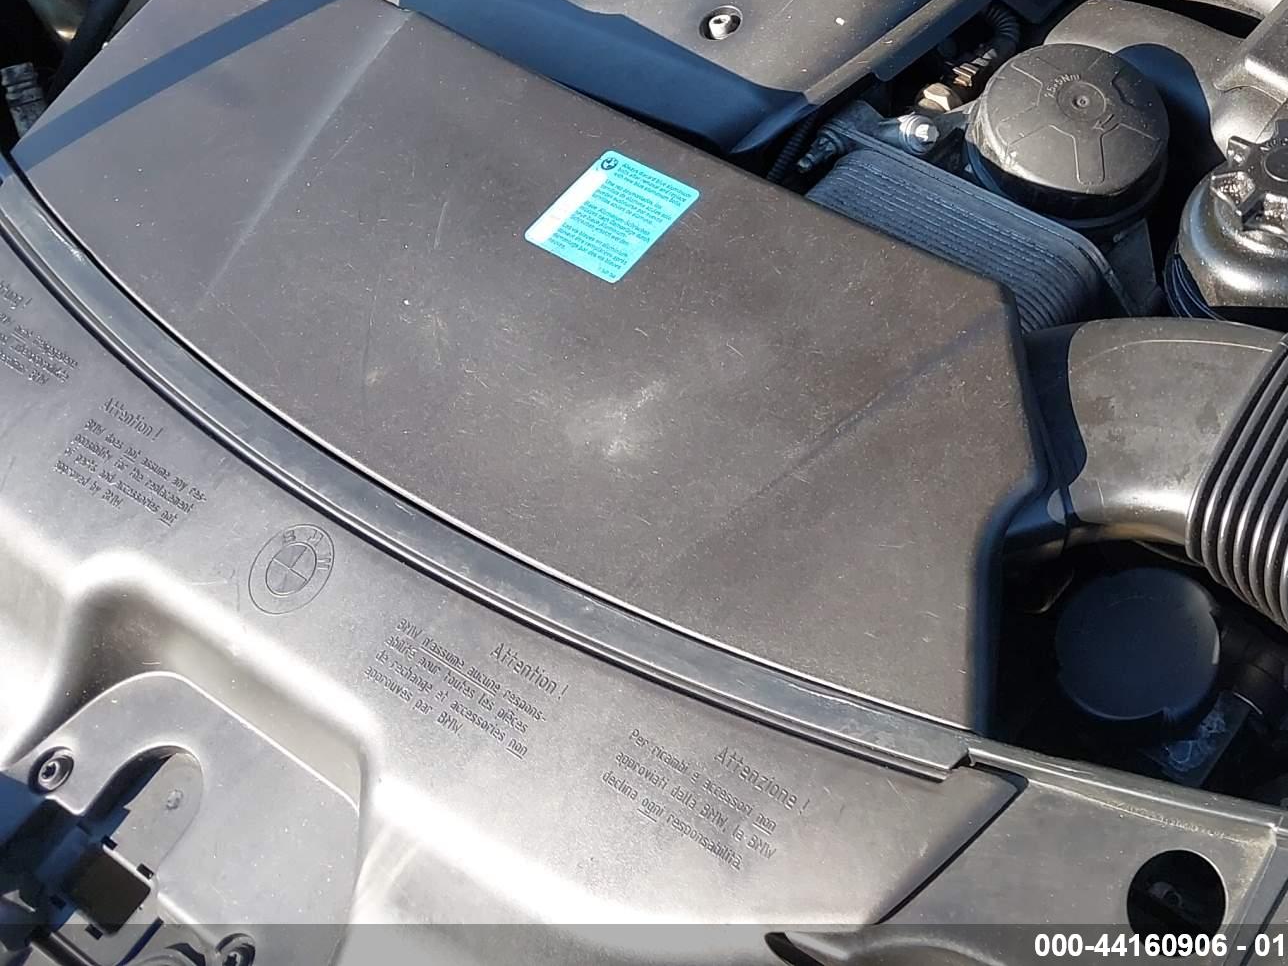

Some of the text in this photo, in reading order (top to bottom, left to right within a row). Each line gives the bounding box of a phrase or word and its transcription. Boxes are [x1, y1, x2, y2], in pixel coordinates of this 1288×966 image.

[89, 481, 101, 496] by
[105, 433, 123, 449] does
[123, 447, 141, 461] not
[141, 457, 170, 481] assume
[171, 476, 187, 491] any
[129, 467, 144, 482] the
[98, 470, 117, 485] and
[160, 510, 179, 525] not
[397, 618, 423, 639] BMW
[422, 636, 465, 670] n'assume
[466, 666, 501, 694] aucune
[418, 655, 441, 676] pour
[443, 669, 476, 699] toutes
[478, 693, 494, 711] les
[375, 650, 390, 664] de
[390, 659, 433, 694] rechange
[435, 689, 449, 703] et
[506, 738, 528, 757] non
[414, 699, 433, 715] par
[601, 770, 639, 801] declina
[639, 798, 666, 819] ogni
[629, 729, 649, 748] Per
[651, 746, 690, 774] ricambi
[702, 778, 755, 818] accessori
[754, 813, 777, 833] non
[670, 786, 698, 810] dalla
[732, 824, 745, 842] la
[747, 835, 777, 860] BMW
